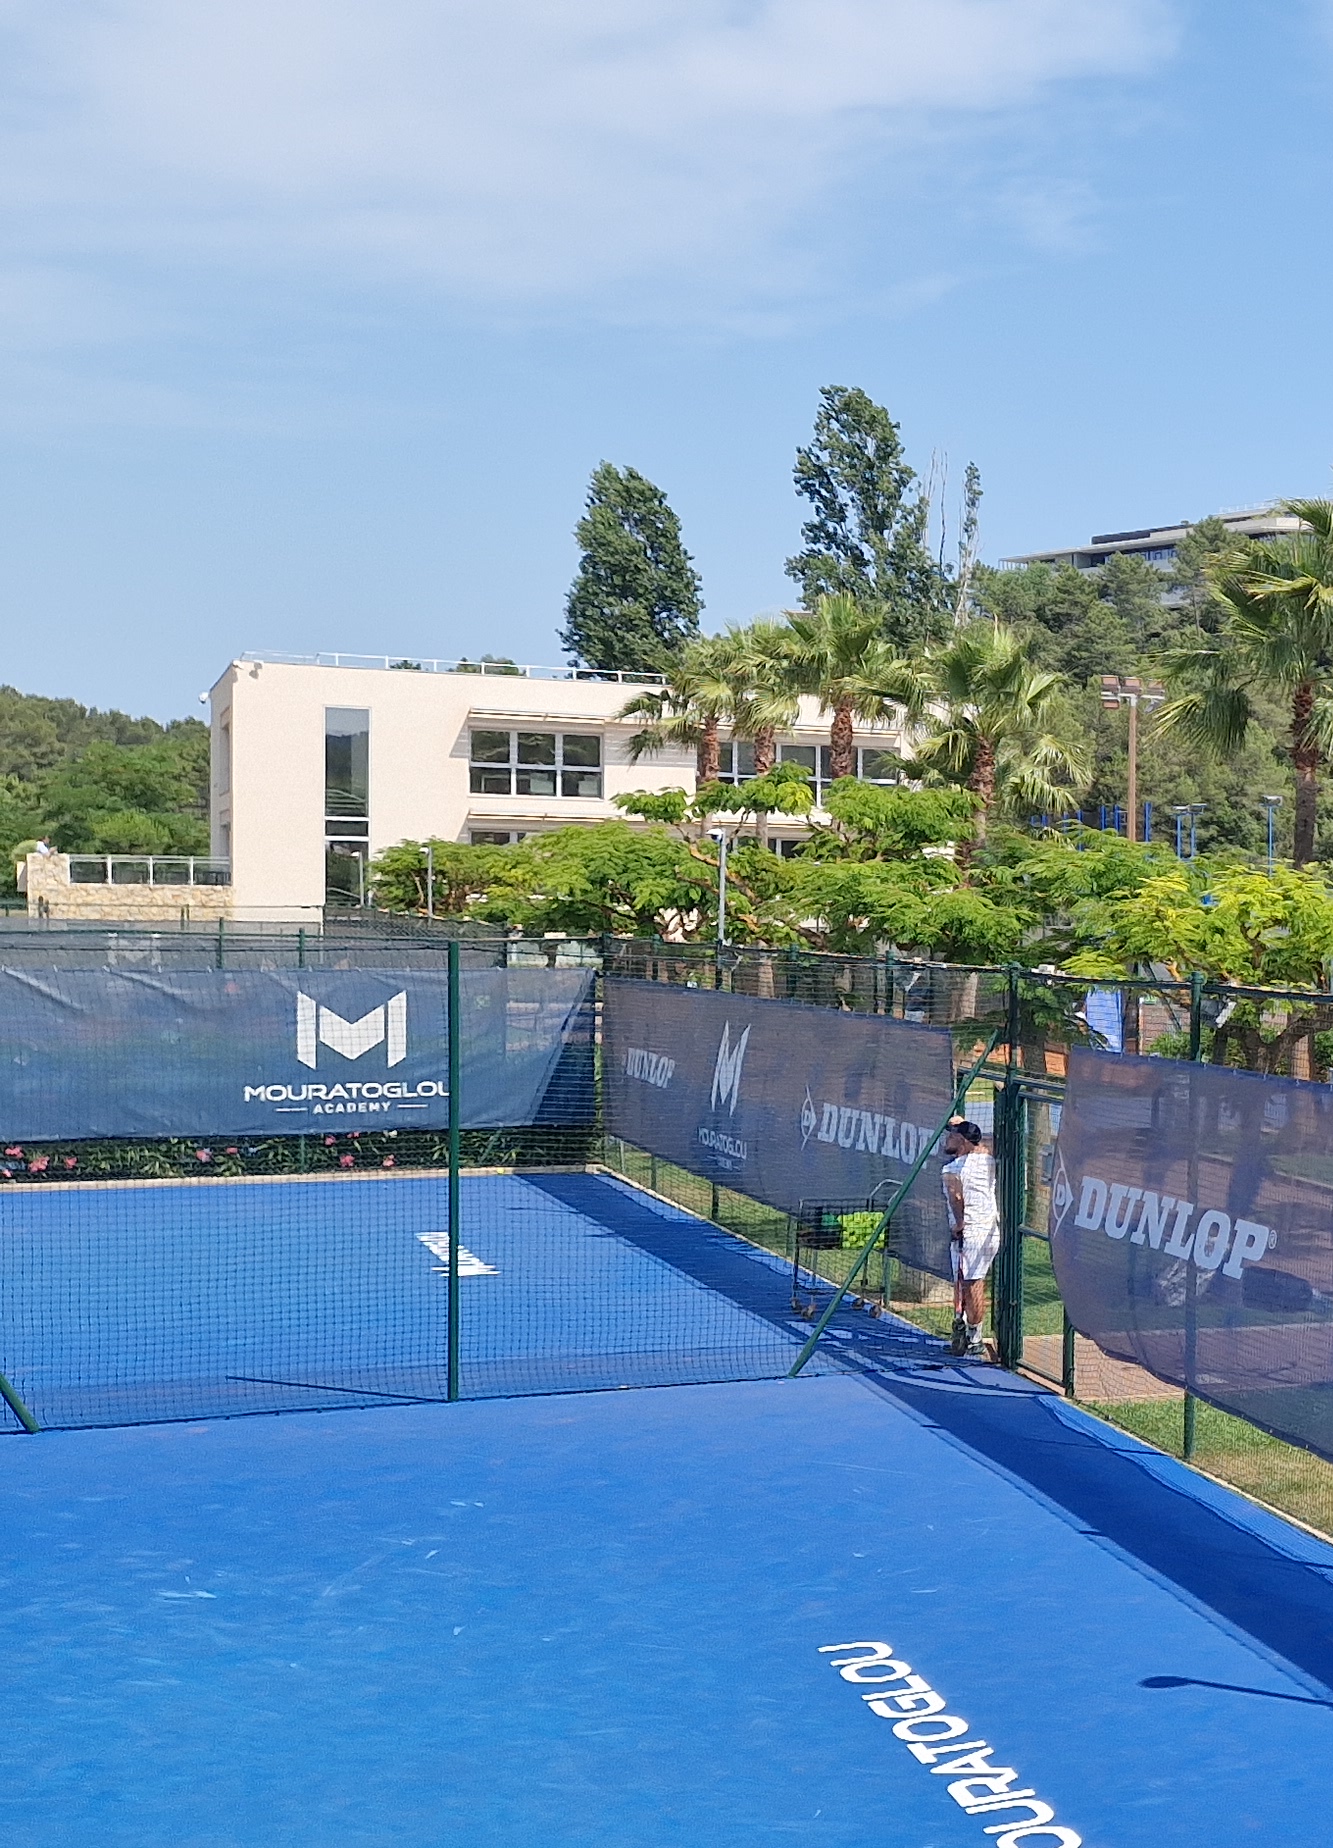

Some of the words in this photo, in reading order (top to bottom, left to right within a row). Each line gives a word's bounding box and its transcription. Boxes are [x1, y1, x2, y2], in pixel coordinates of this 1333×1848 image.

[626, 1047, 676, 1089] DUNLOP
[312, 1101, 391, 1115] ACADEMY
[817, 1641, 1082, 1848] OURATOGLOU
